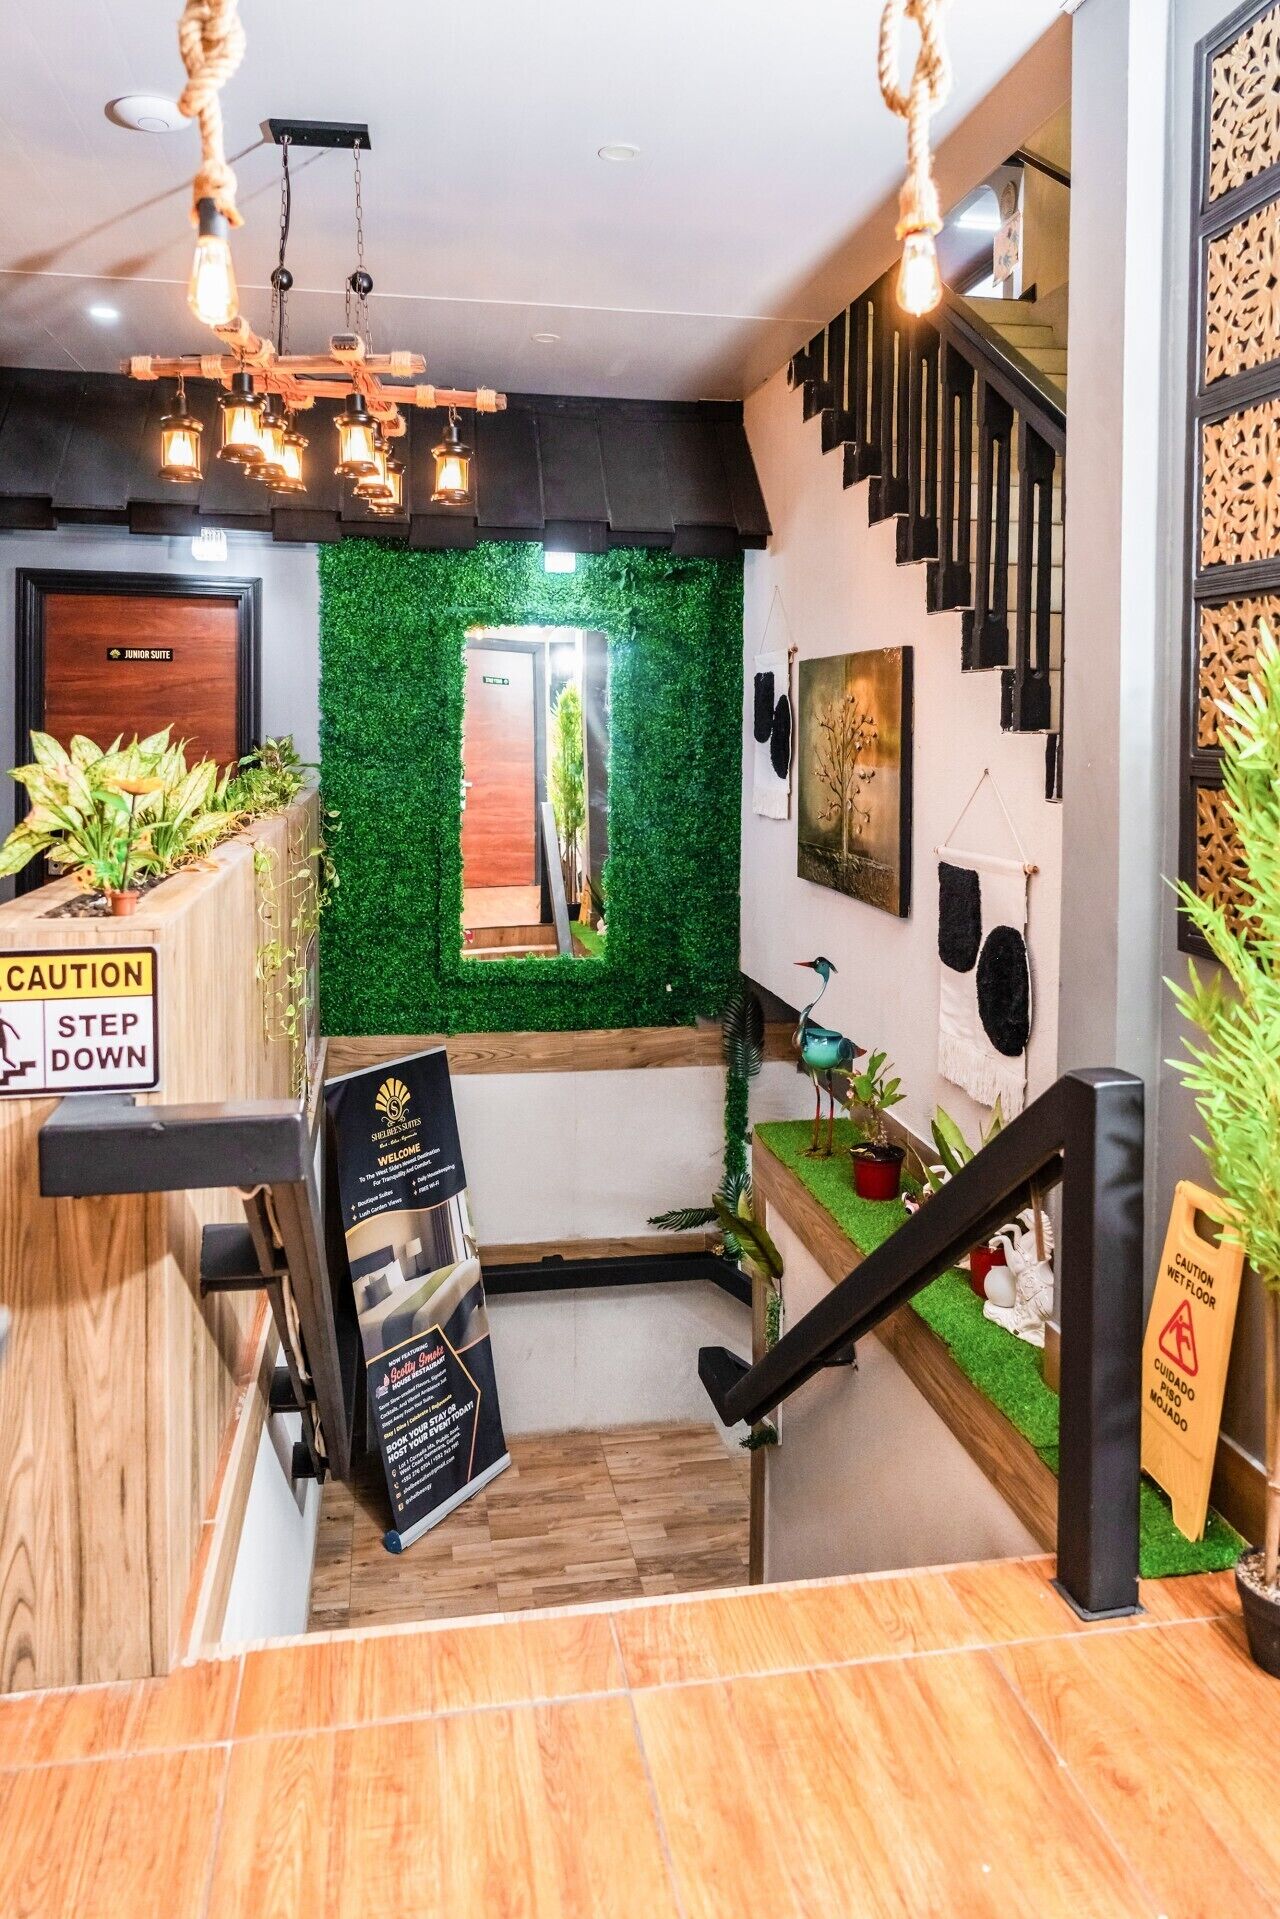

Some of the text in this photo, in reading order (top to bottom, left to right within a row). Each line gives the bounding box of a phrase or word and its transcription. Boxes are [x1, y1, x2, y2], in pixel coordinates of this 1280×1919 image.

[125, 650, 170, 659] JUNIOR SUITE
[7, 962, 142, 991] CAUTION
[59, 1013, 138, 1038] STEP
[52, 1046, 145, 1071] DOWN
[378, 1143, 421, 1167] WELCOME
[365, 1172, 375, 1180] The
[376, 1167, 388, 1177] West
[358, 1190, 393, 1207] Boutique Suites
[359, 1198, 402, 1218] Lush Garden Views
[1175, 1253, 1214, 1288] CAUTION
[1167, 1265, 1216, 1310] WET FLOOR
[388, 1342, 428, 1367] NOW FEATURING
[390, 1345, 444, 1384] Scotty Smoke
[392, 1355, 445, 1391] HOUSE RESTAURANT
[1154, 1358, 1195, 1401] CUIDADO
[1160, 1381, 1182, 1408] PISO
[404, 1407, 414, 1415] From
[1149, 1389, 1188, 1432] MOJADO
[384, 1430, 394, 1440] Stay
[386, 1404, 456, 1454] BOOK YOUR STAY OR
[388, 1446, 408, 1463] HOST
[409, 1432, 428, 1449] YOUR
[429, 1418, 451, 1436] EVENT
